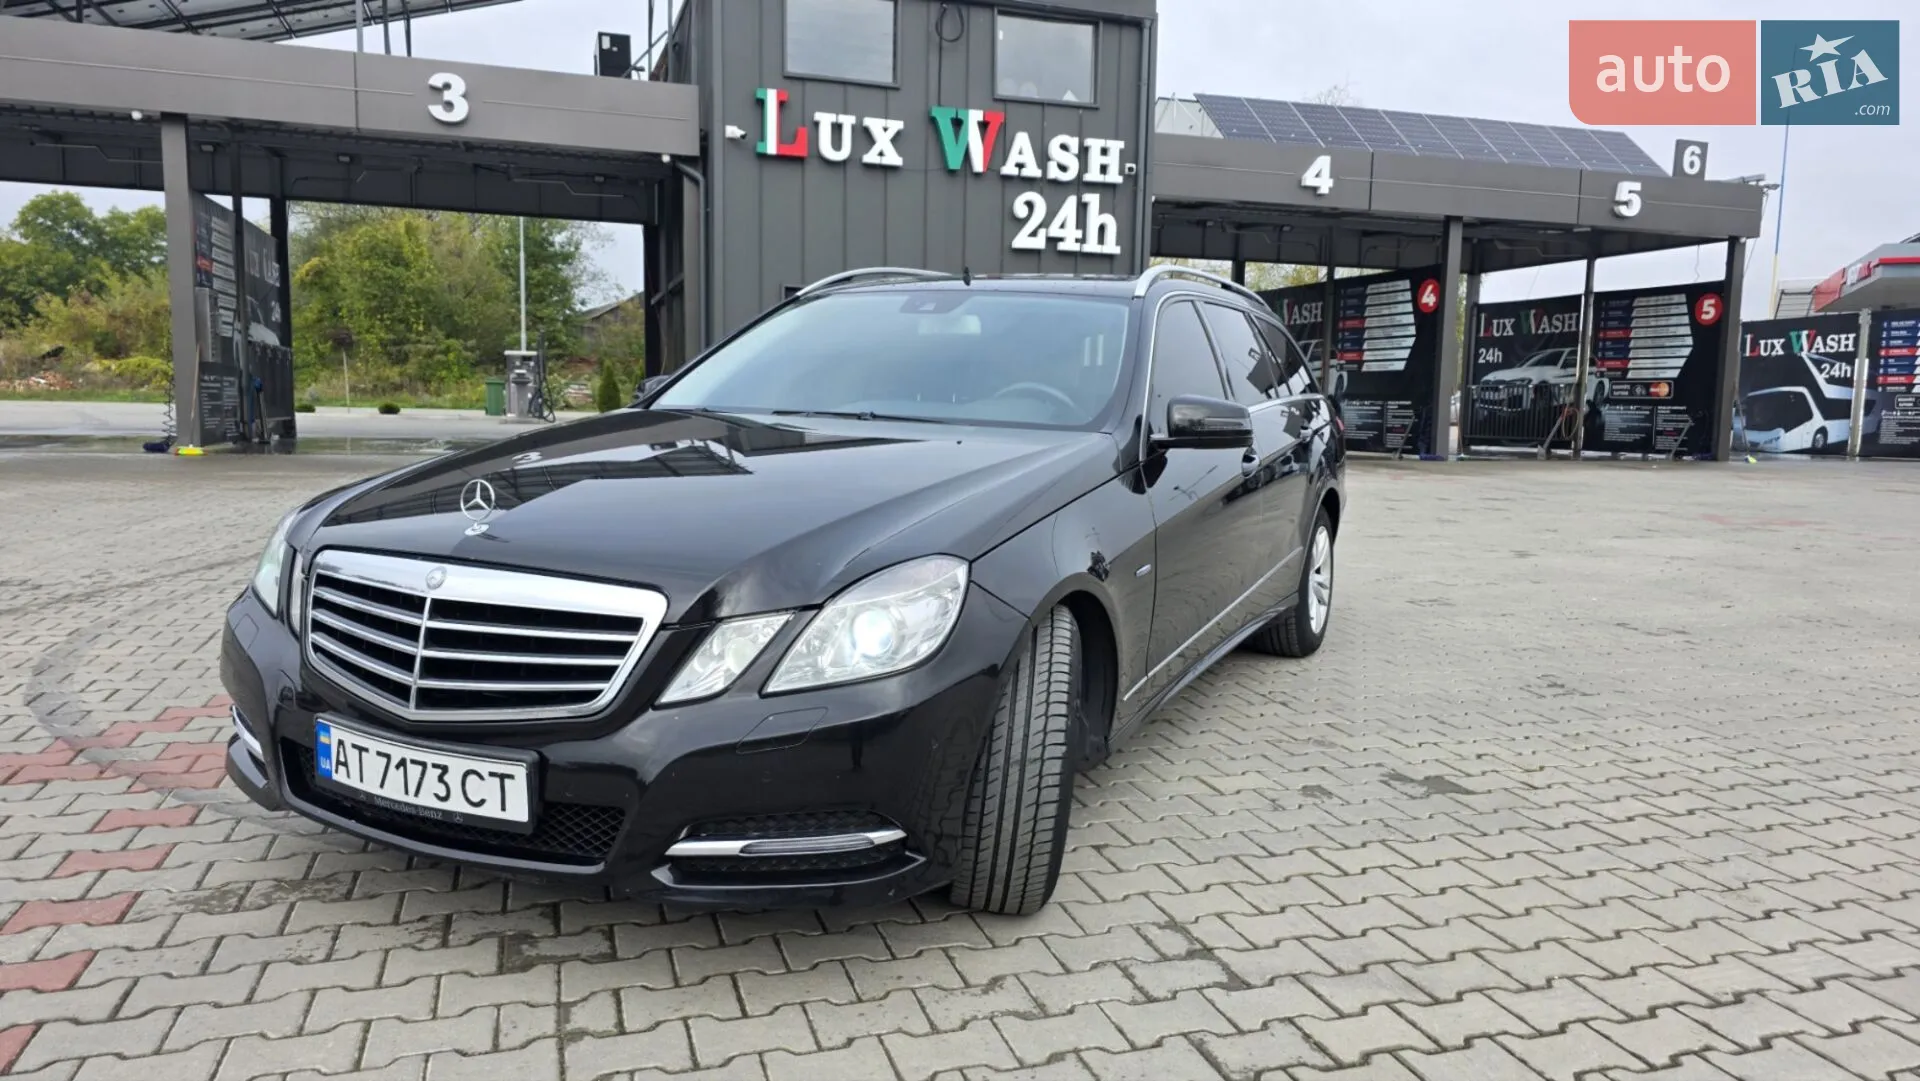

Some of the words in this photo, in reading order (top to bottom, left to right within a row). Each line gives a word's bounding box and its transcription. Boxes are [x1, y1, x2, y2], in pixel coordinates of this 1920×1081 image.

[427, 72, 469, 122] 3
[755, 87, 905, 168] LUX
[929, 106, 1125, 184] WASH
[1682, 145, 1701, 175] 6
[1301, 155, 1334, 195] 4
[1613, 181, 1642, 218] 5
[1011, 191, 1121, 255] 24h
[1421, 284, 1437, 307] 4
[1701, 299, 1715, 320] 5
[1479, 312, 1515, 337] LUX
[1520, 308, 1579, 335] WASH
[1478, 347, 1503, 363] 24h
[1744, 333, 1785, 357] LUX
[1789, 330, 1856, 355] WASH
[1820, 362, 1851, 379] 24h
[320, 757, 331, 770] UA
